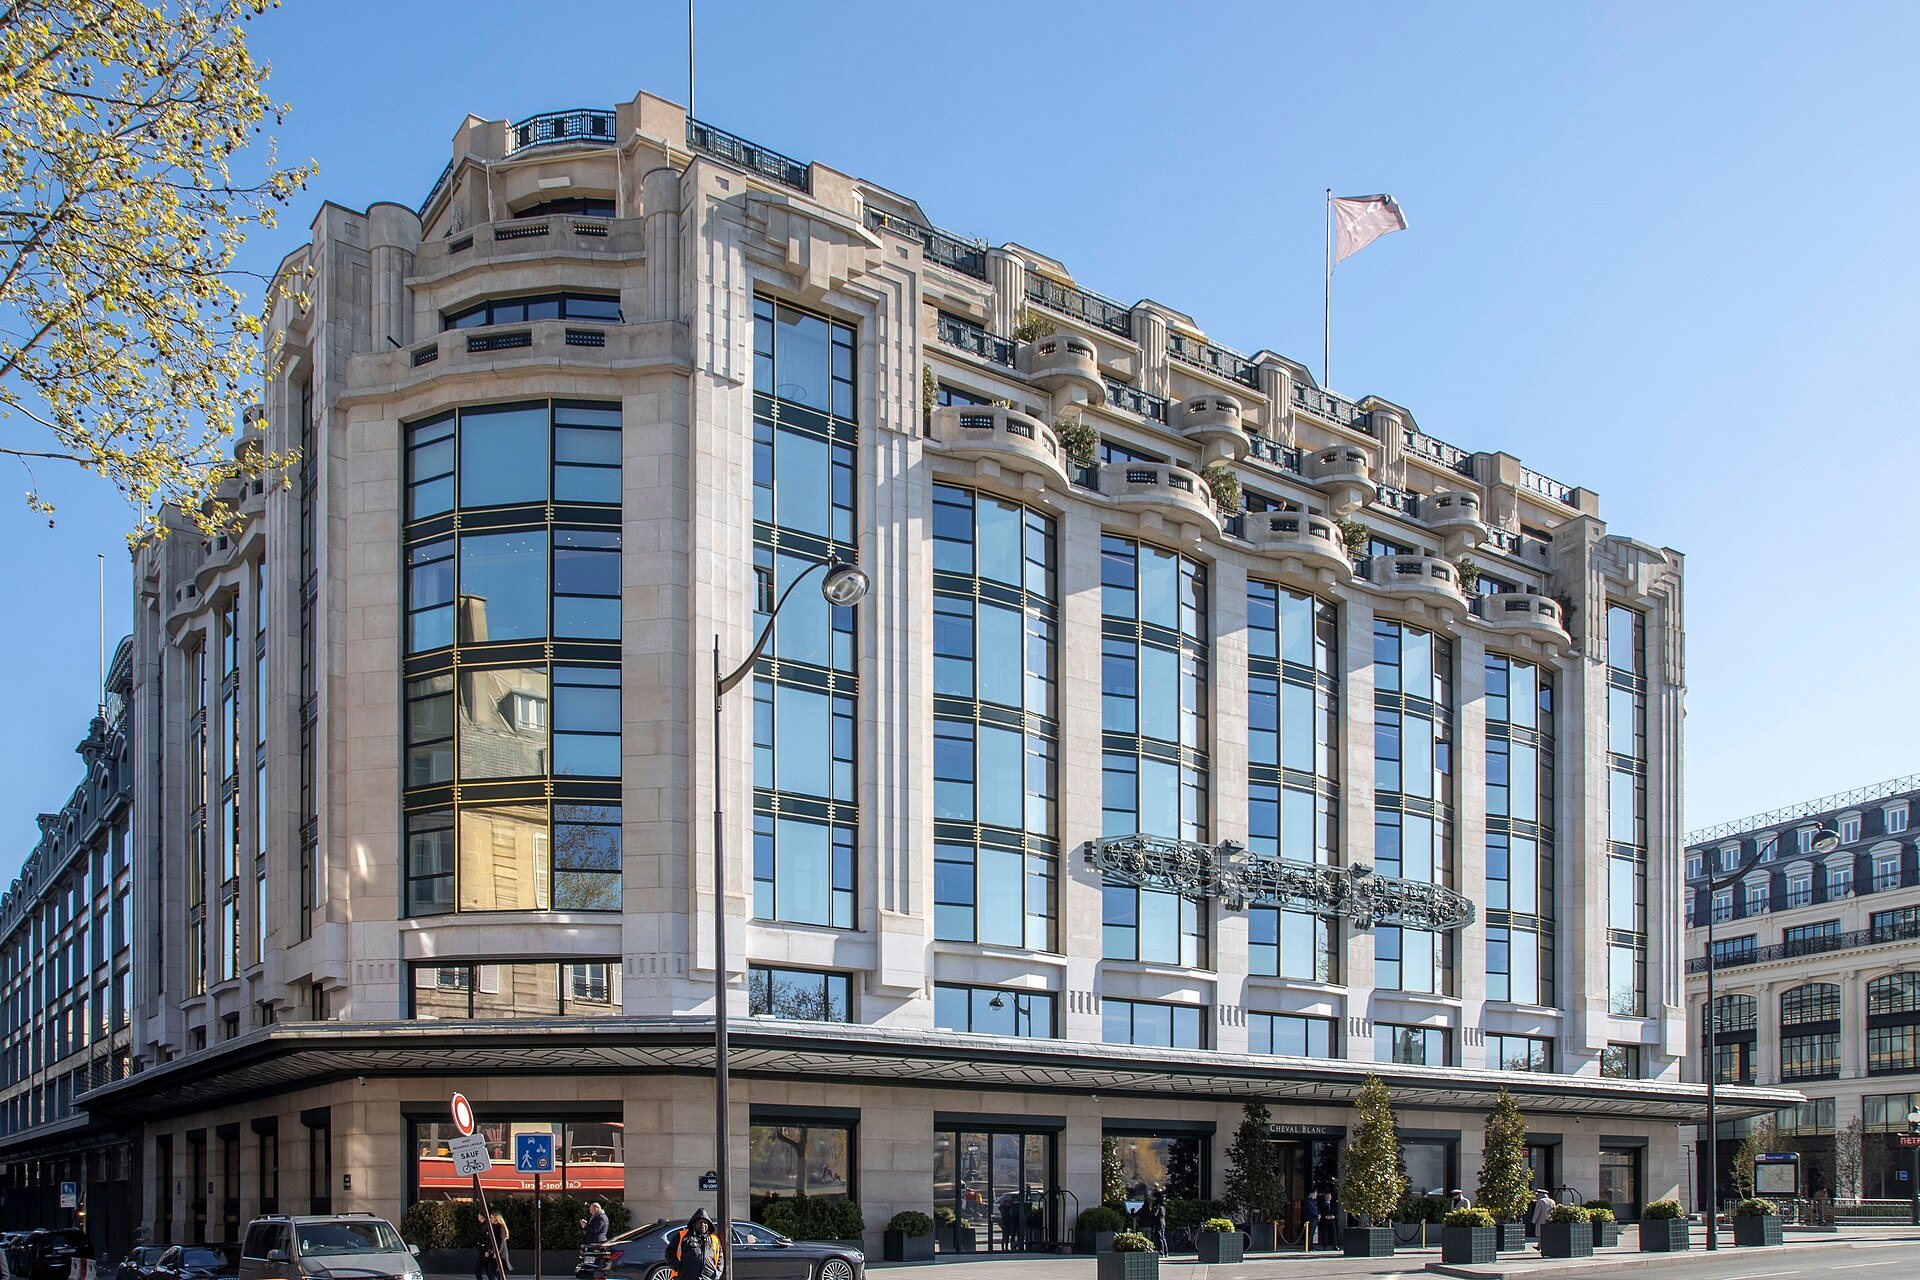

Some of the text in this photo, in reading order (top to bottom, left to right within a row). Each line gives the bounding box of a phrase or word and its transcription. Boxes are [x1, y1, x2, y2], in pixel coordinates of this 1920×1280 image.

[1270, 1124, 1326, 1134] CHEVAL BLANC
[460, 1150, 479, 1159] SAUF
